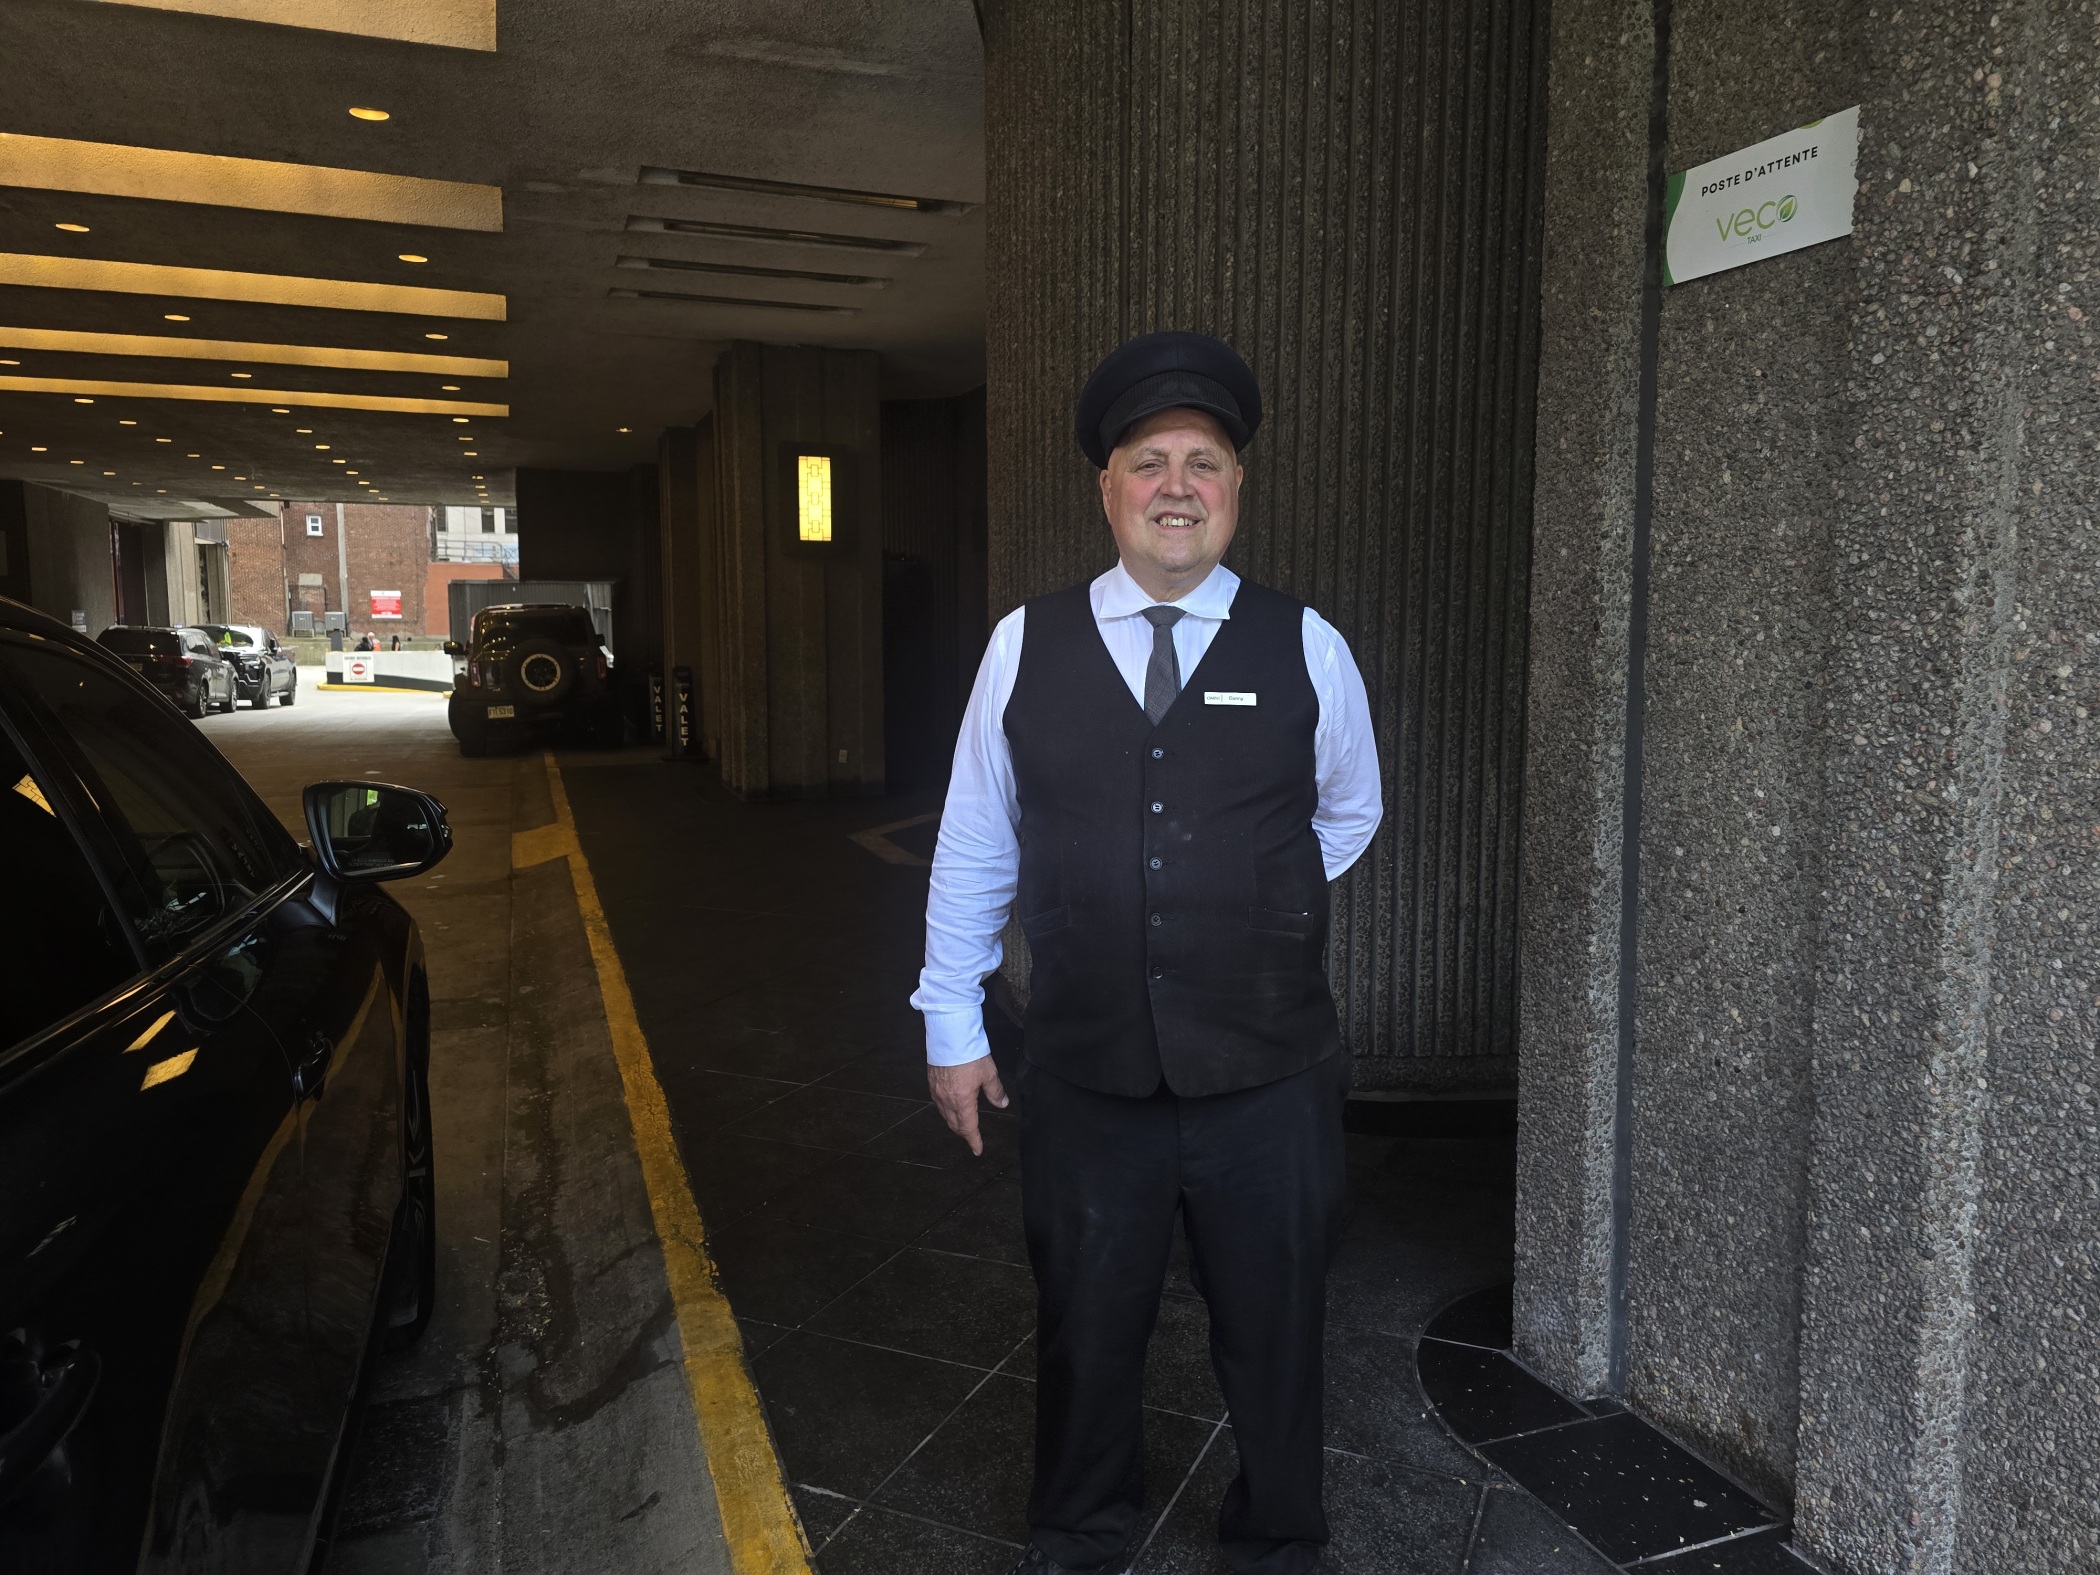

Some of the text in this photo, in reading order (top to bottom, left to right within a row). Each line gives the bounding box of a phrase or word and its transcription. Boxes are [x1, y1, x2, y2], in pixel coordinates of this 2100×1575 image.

[1701, 146, 1819, 197] POSTE D'ATTENTE
[1716, 194, 1798, 242] veco
[1746, 233, 1762, 245] TAXI
[653, 686, 663, 732] VALET
[679, 693, 689, 746] VALET
